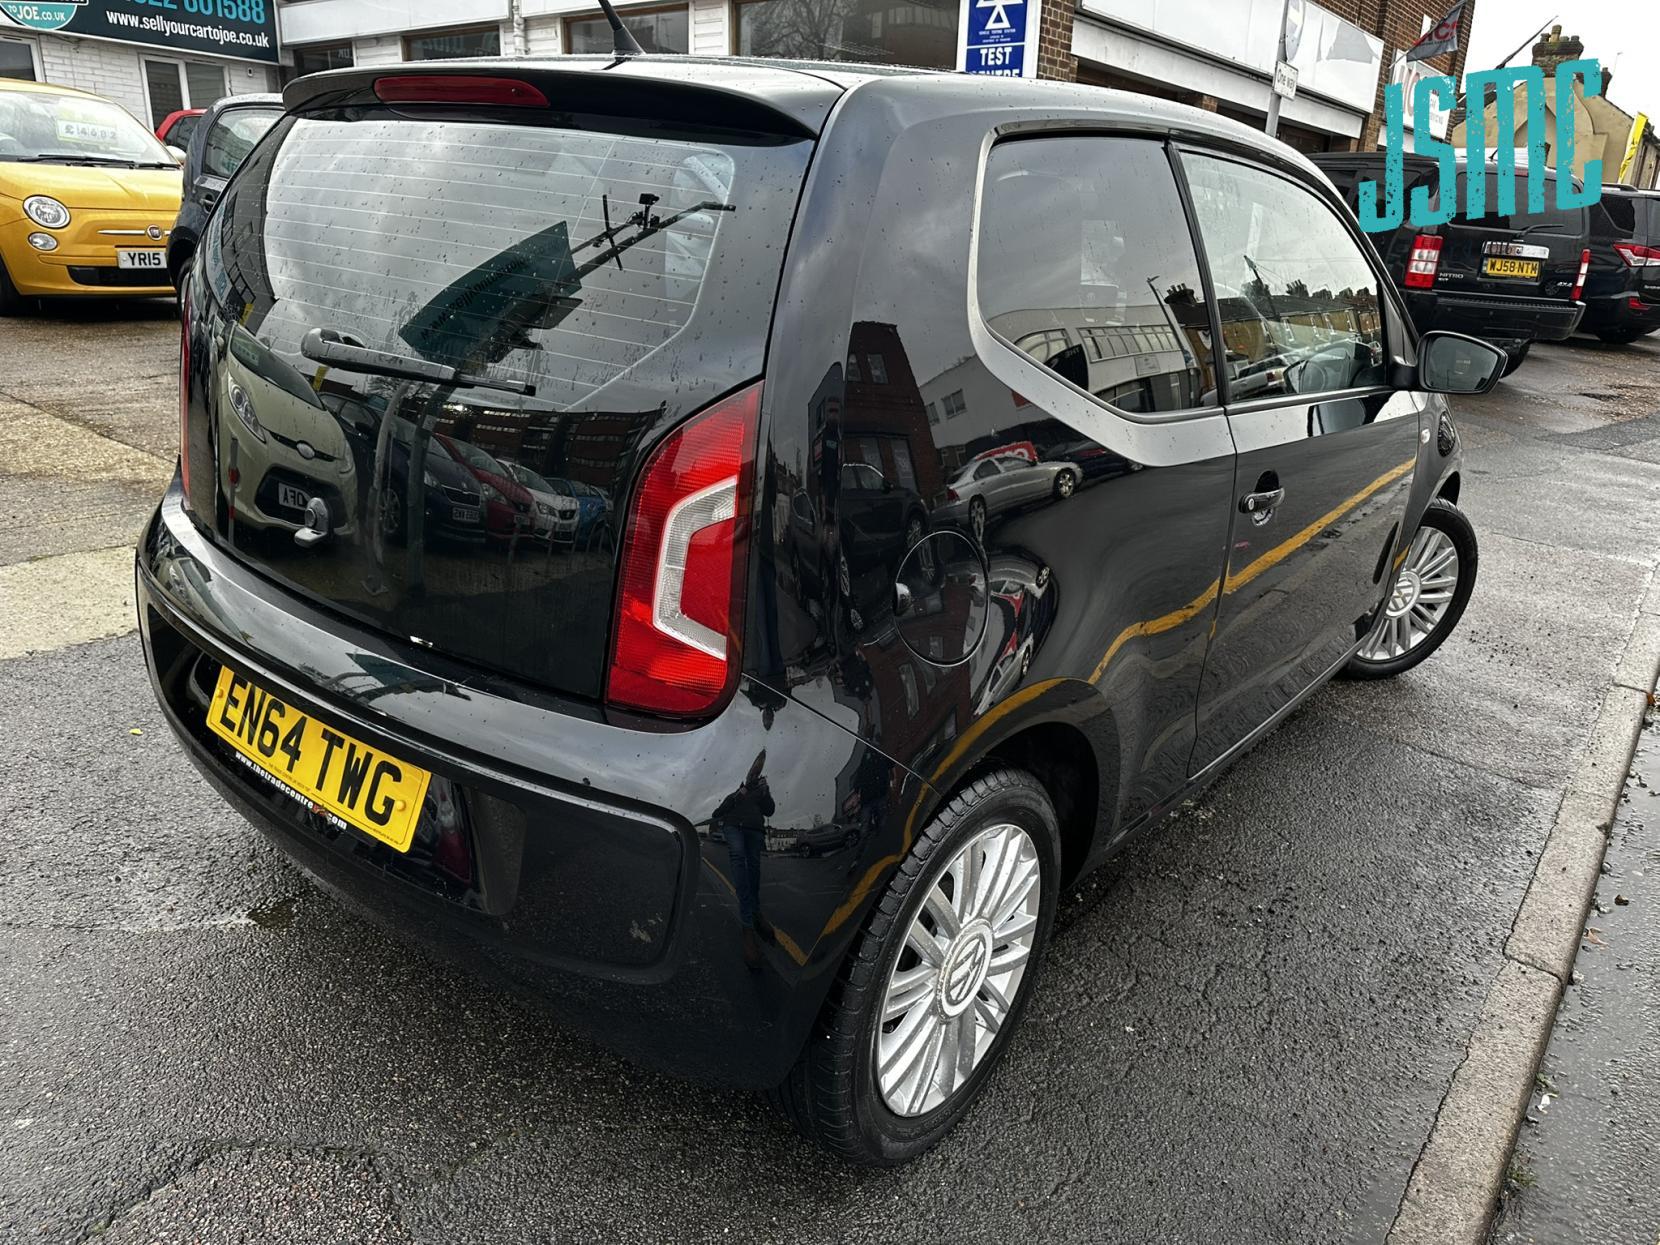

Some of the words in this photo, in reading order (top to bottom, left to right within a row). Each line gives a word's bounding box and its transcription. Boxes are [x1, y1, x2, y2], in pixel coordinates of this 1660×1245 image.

[17, 6, 66, 21] JOE.CO.UK
[106, 10, 270, 49] www.sellyourcartojoe.co.uk
[980, 47, 1012, 66] TEST
[127, 252, 161, 266] YR15
[1489, 259, 1515, 273] WJ58
[220, 672, 307, 773] EN64
[315, 727, 402, 826] TWG
